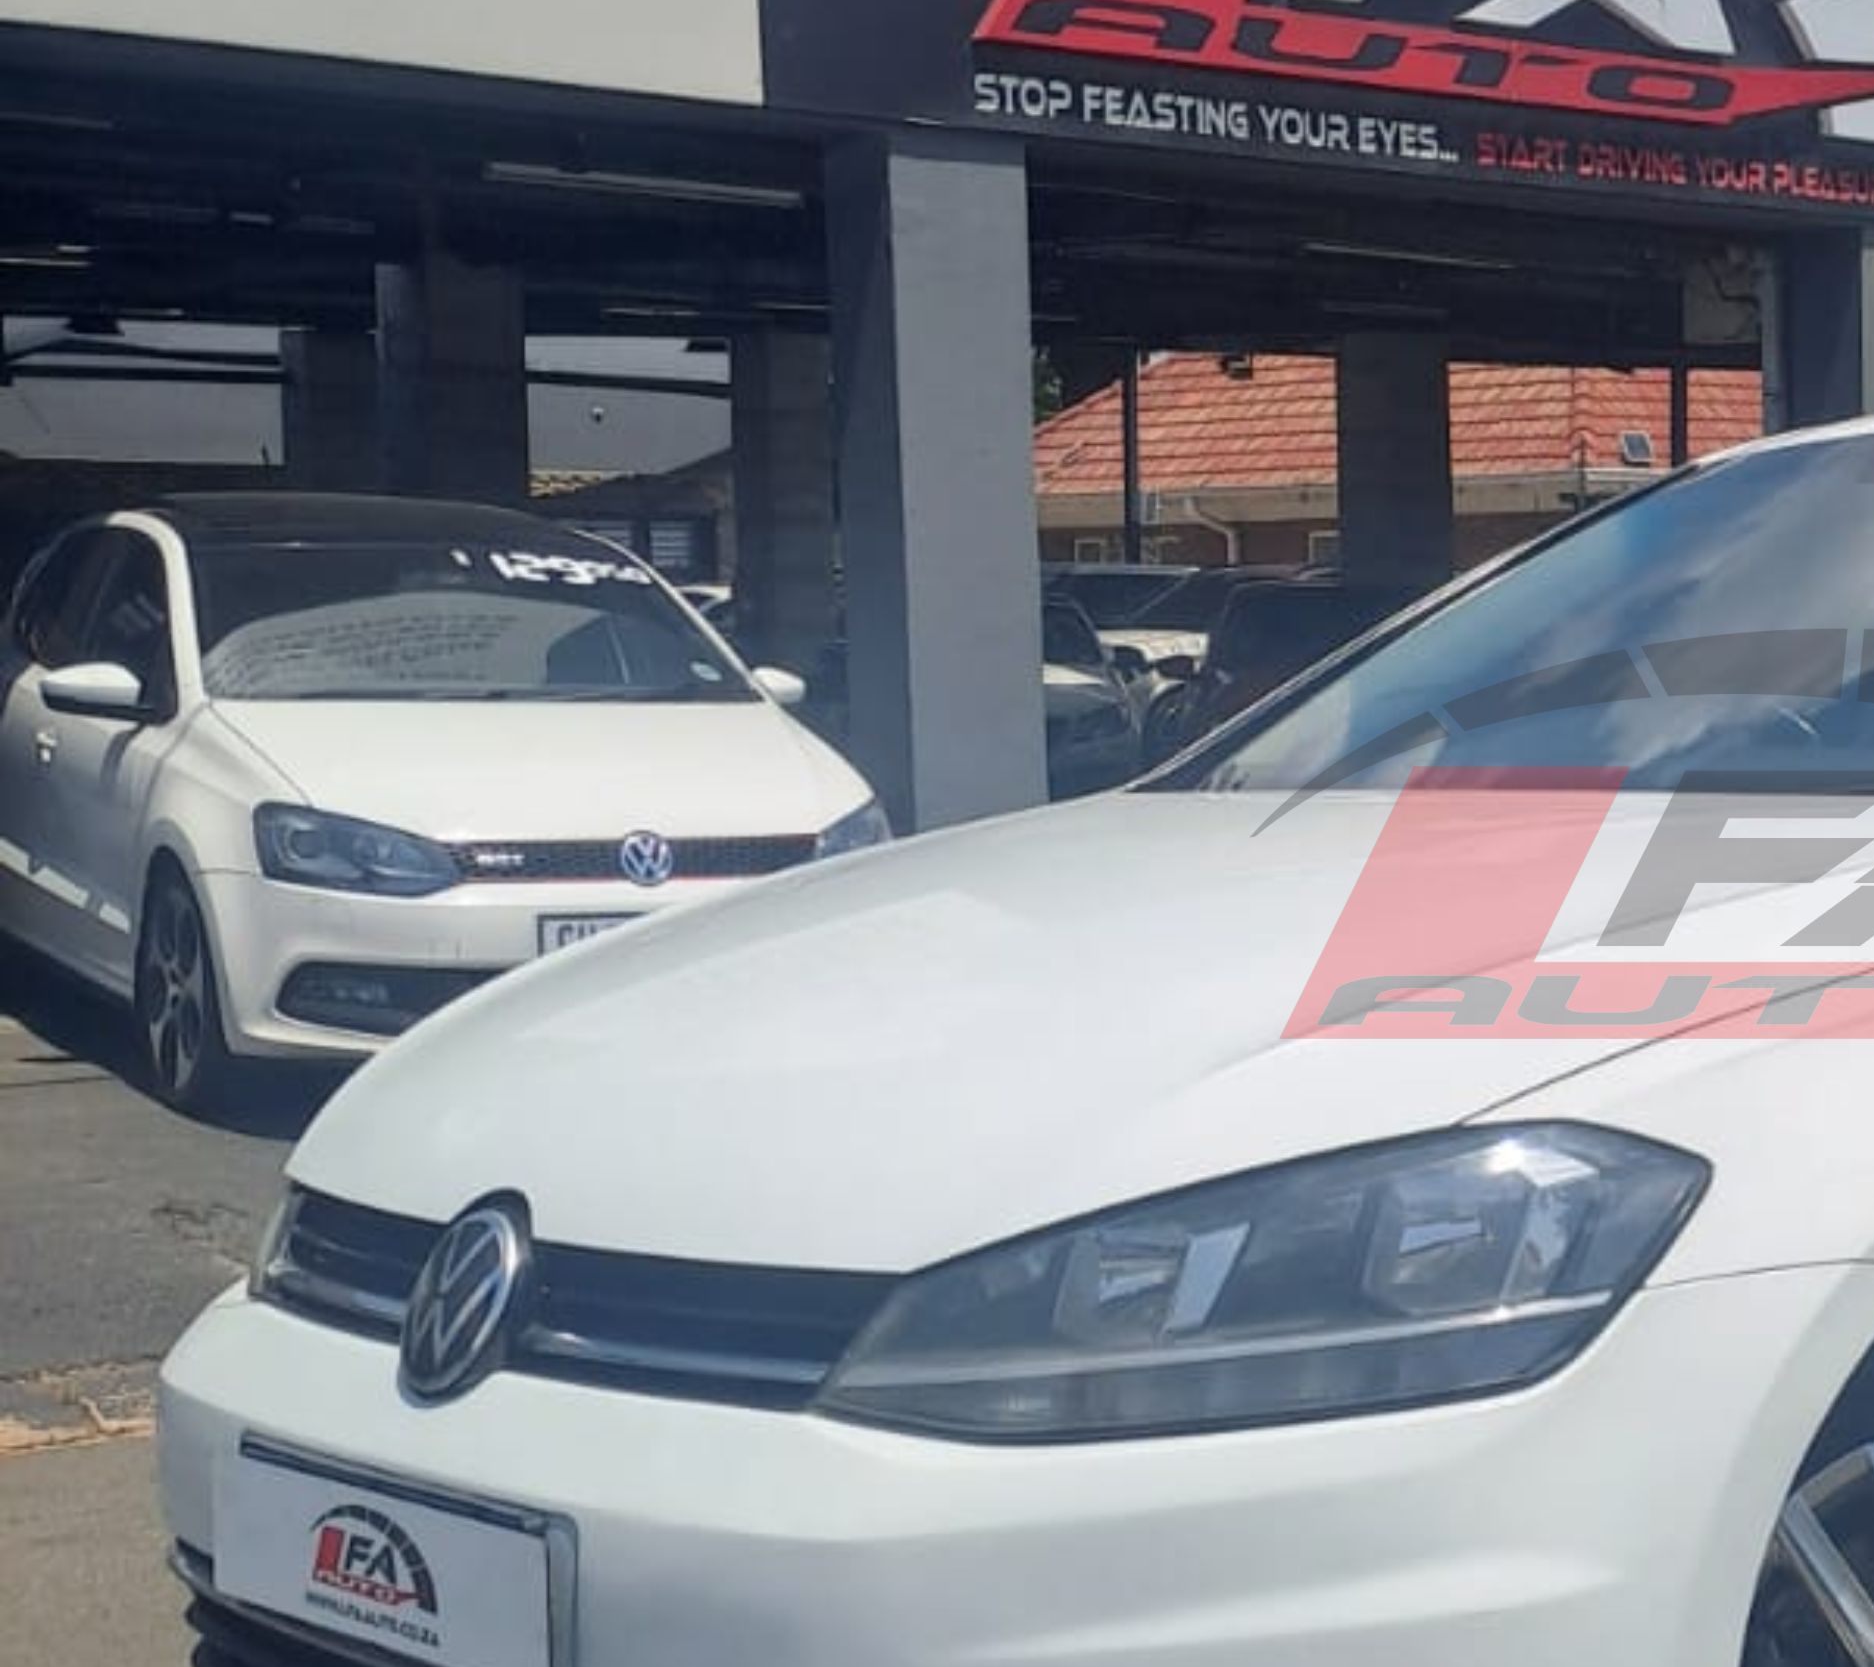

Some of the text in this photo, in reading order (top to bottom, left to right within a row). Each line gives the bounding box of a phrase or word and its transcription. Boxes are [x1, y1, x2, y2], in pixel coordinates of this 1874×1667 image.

[973, 72, 1072, 119] STOP
[1082, 85, 1249, 140] FEASTING
[1257, 104, 1351, 152] YOUR
[1357, 117, 1459, 163] EYES...
[1475, 132, 1567, 172] START
[1577, 142, 1688, 185] DRIVING
[1697, 154, 1767, 194] YOUR
